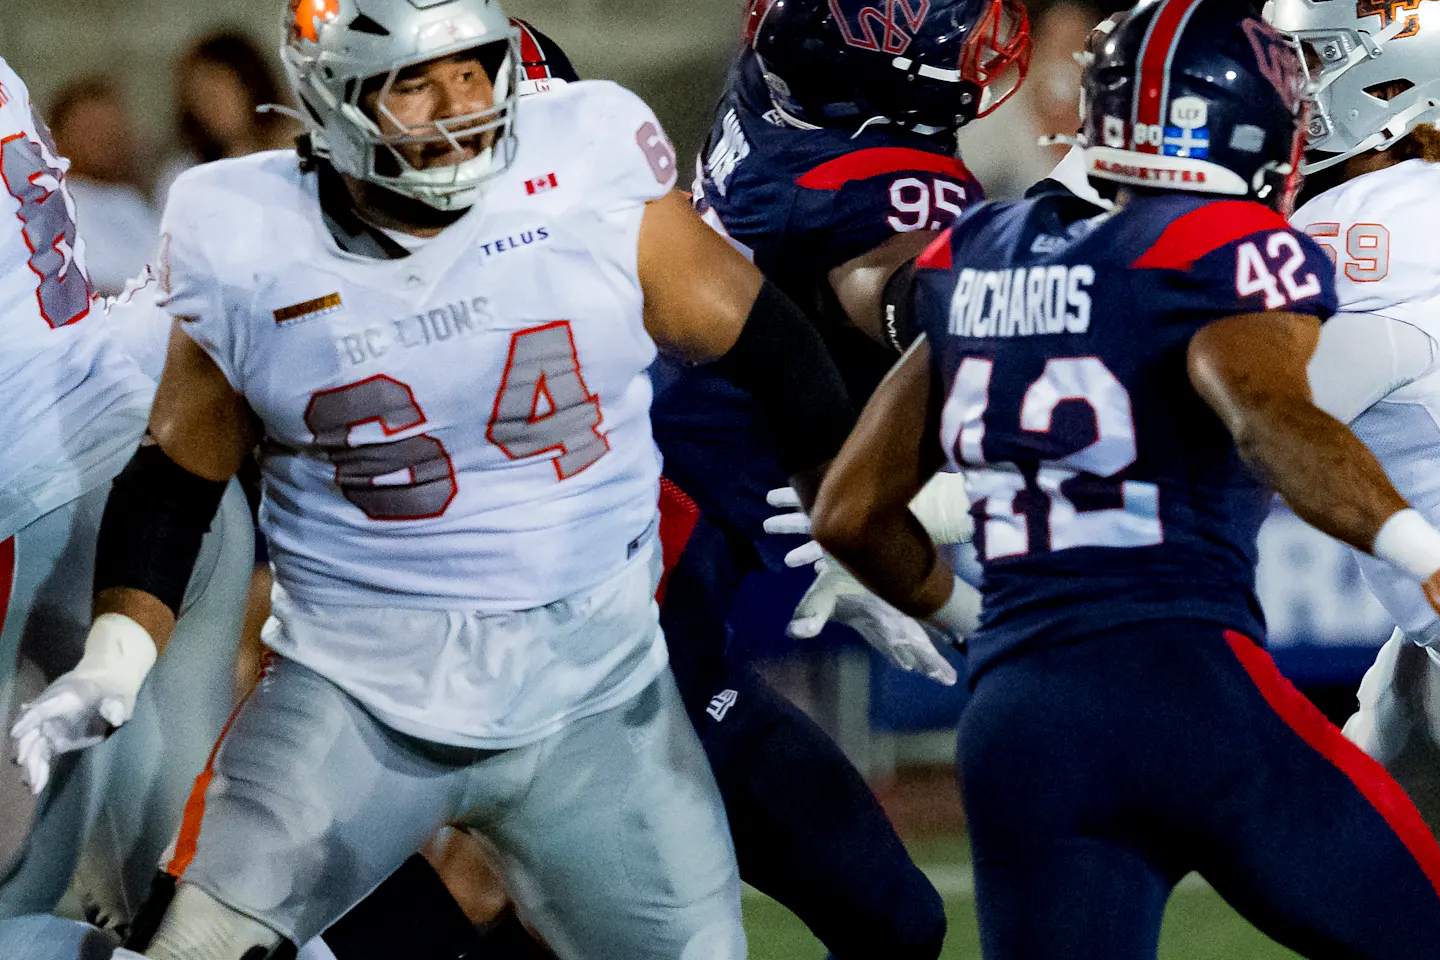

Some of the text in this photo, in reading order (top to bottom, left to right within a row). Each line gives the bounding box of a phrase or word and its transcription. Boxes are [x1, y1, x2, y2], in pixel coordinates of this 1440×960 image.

[480, 226, 549, 257] TELUS
[887, 177, 967, 233] 95
[949, 264, 1096, 338] RICHARDS
[1235, 230, 1322, 310] 42
[341, 328, 386, 366] BC
[392, 297, 493, 350] LIONS
[303, 319, 610, 521] 64
[939, 355, 1164, 561] 42
